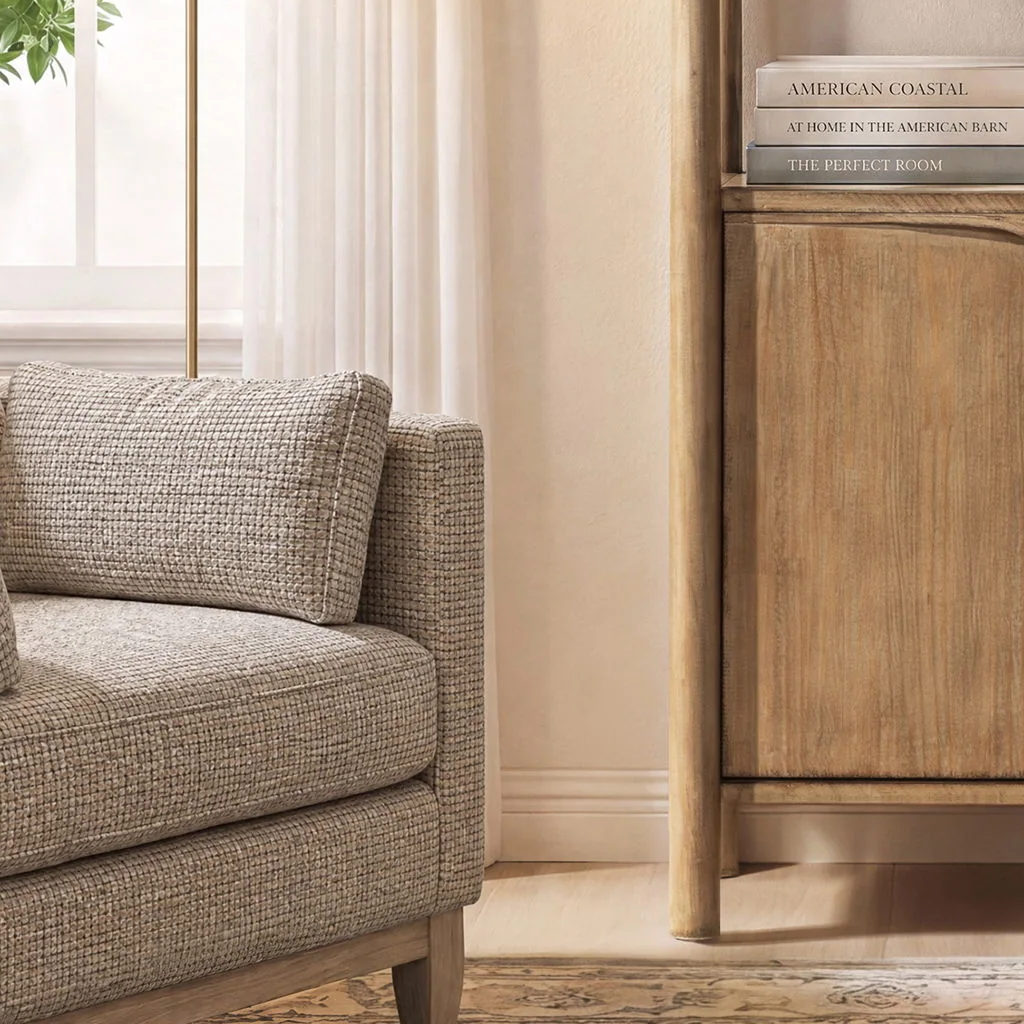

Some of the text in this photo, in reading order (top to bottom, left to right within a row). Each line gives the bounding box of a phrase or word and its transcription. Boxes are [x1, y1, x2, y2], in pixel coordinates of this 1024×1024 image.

[787, 82, 969, 96] AMERICAN COASTAL
[786, 121, 1008, 133] AT HOME IN THE AMERICAN BARN
[787, 159, 943, 172] THE PERFECT ROOM
